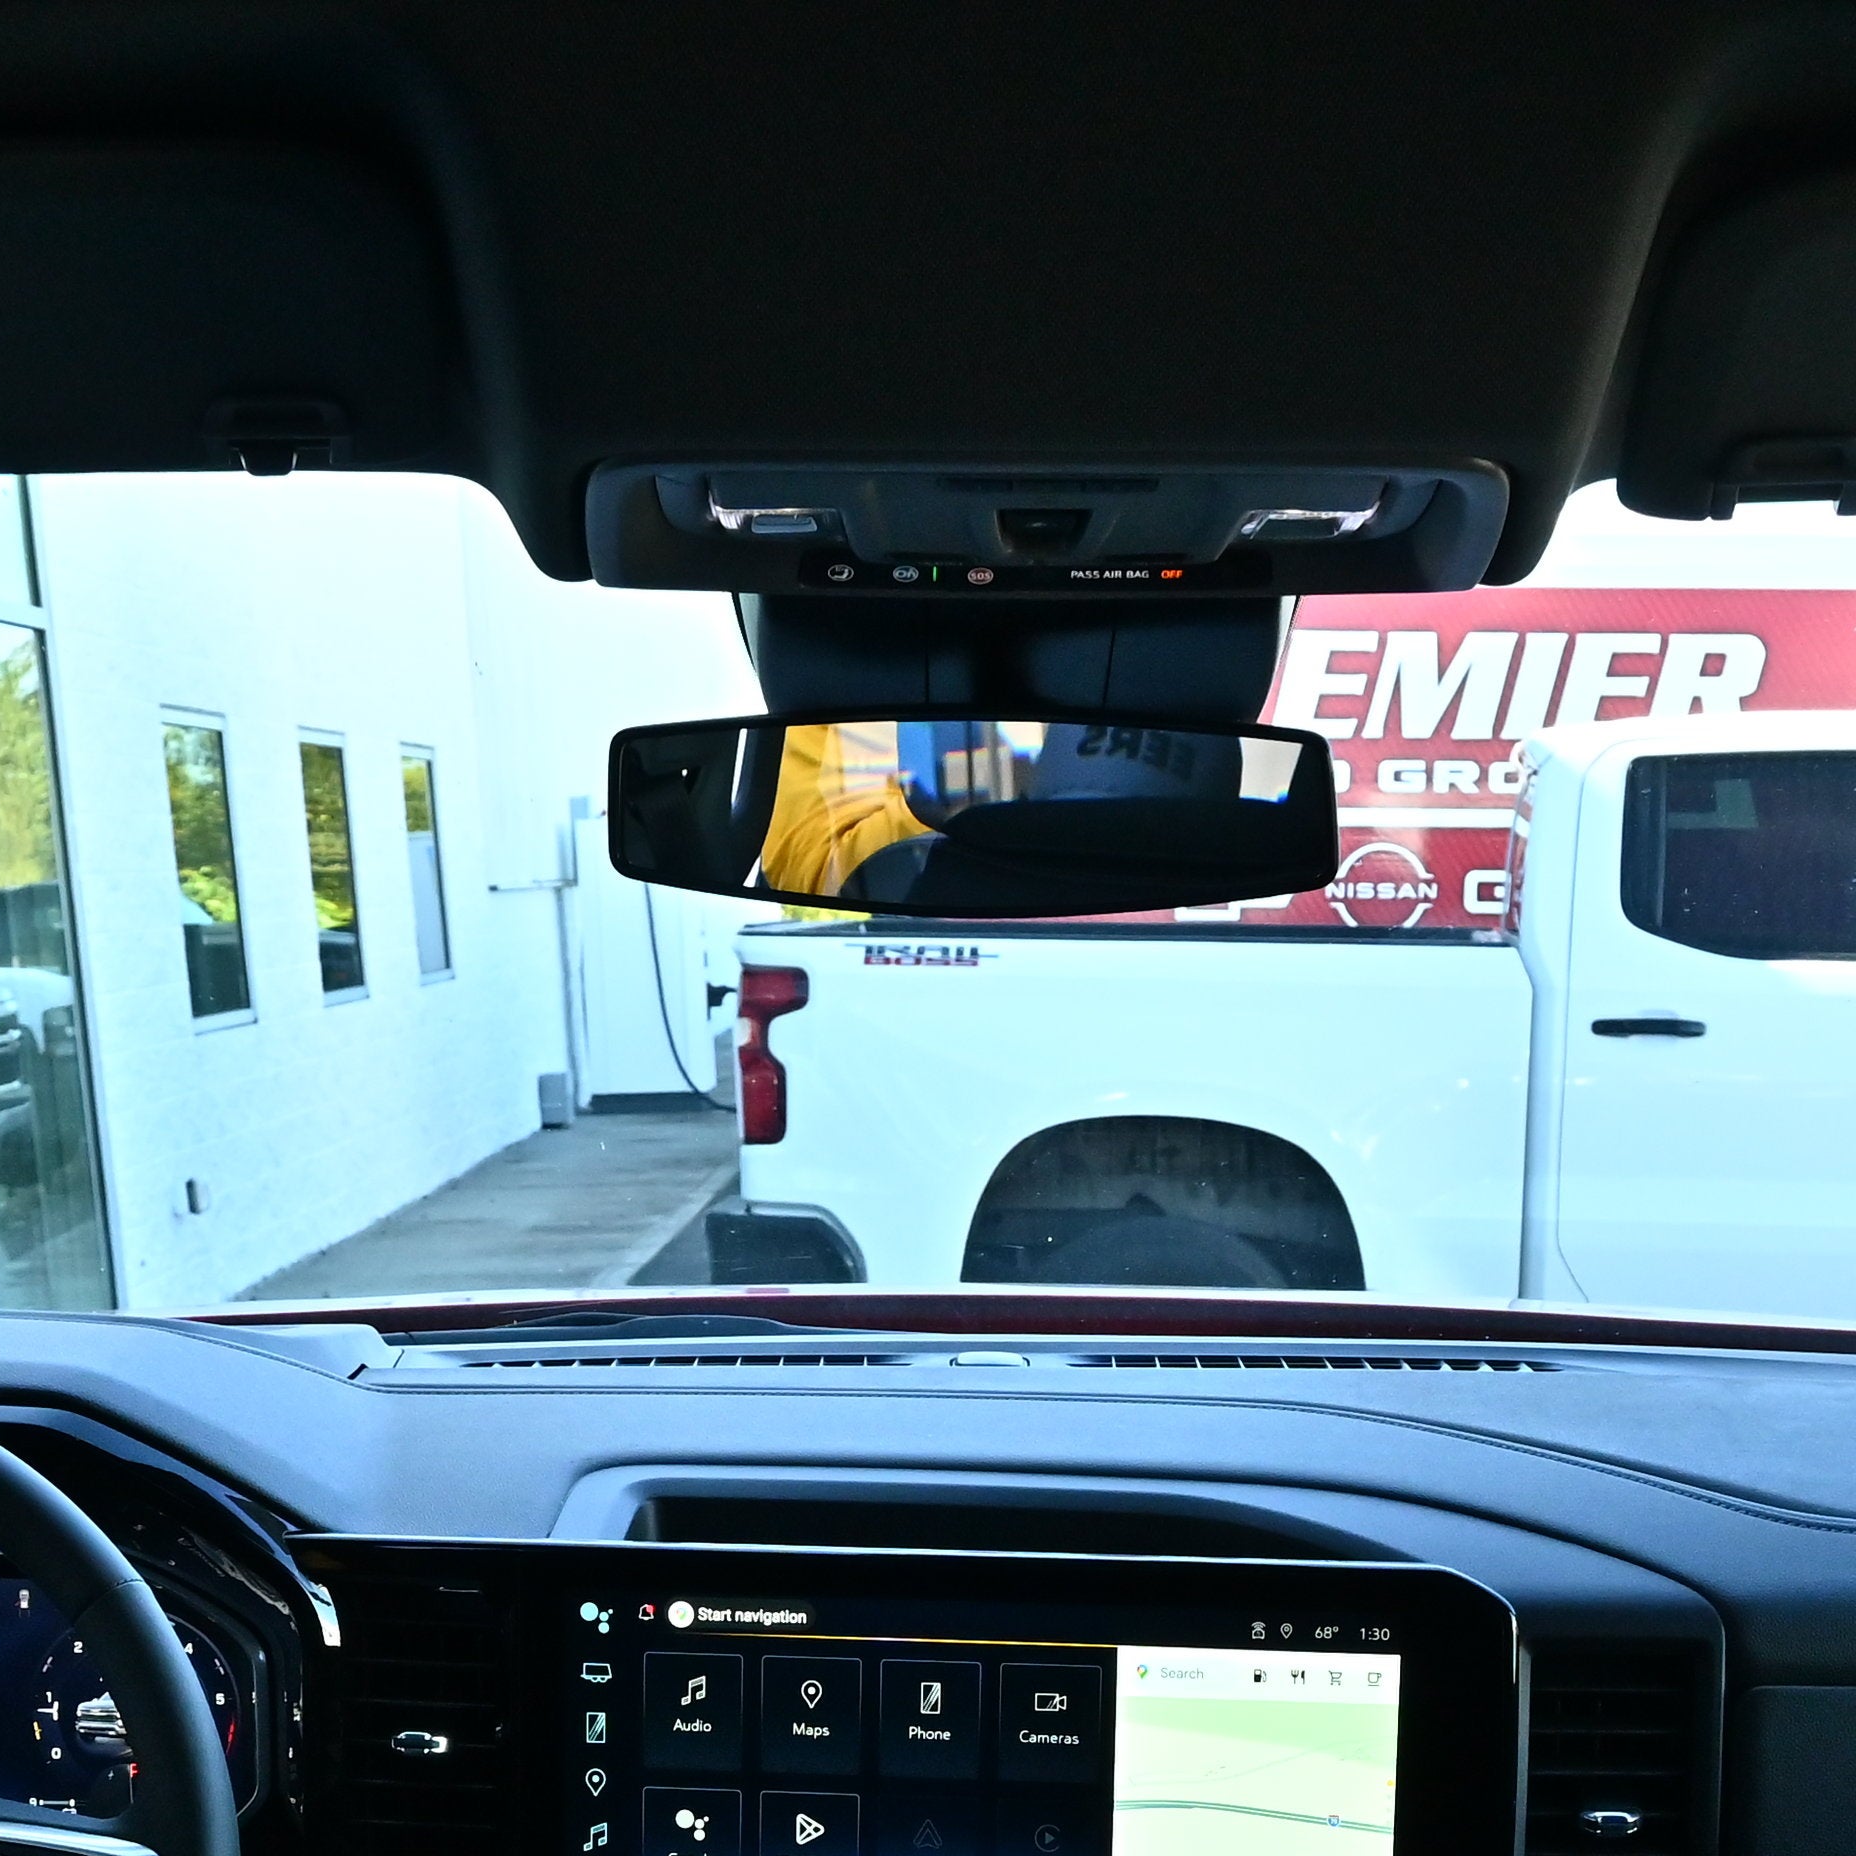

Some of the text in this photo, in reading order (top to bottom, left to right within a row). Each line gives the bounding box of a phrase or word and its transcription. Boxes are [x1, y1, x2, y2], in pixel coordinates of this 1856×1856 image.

[1070, 569, 1183, 579] PASS AIR BAG OFF
[1325, 882, 1438, 900] NISSAN
[697, 1609, 807, 1626] Start navigation
[1315, 1626, 1339, 1639] 68°
[1359, 1628, 1390, 1641] 1:30
[73, 1641, 84, 1654] 2
[183, 1642, 194, 1655] 4
[1160, 1667, 1205, 1680] Search
[46, 1691, 53, 1703] 1
[215, 1693, 225, 1705] 5
[673, 1718, 712, 1732] Audio
[792, 1722, 831, 1739] Maps
[908, 1726, 951, 1740] Phone
[1019, 1730, 1080, 1745] Cameras
[51, 1747, 62, 1760] 0
